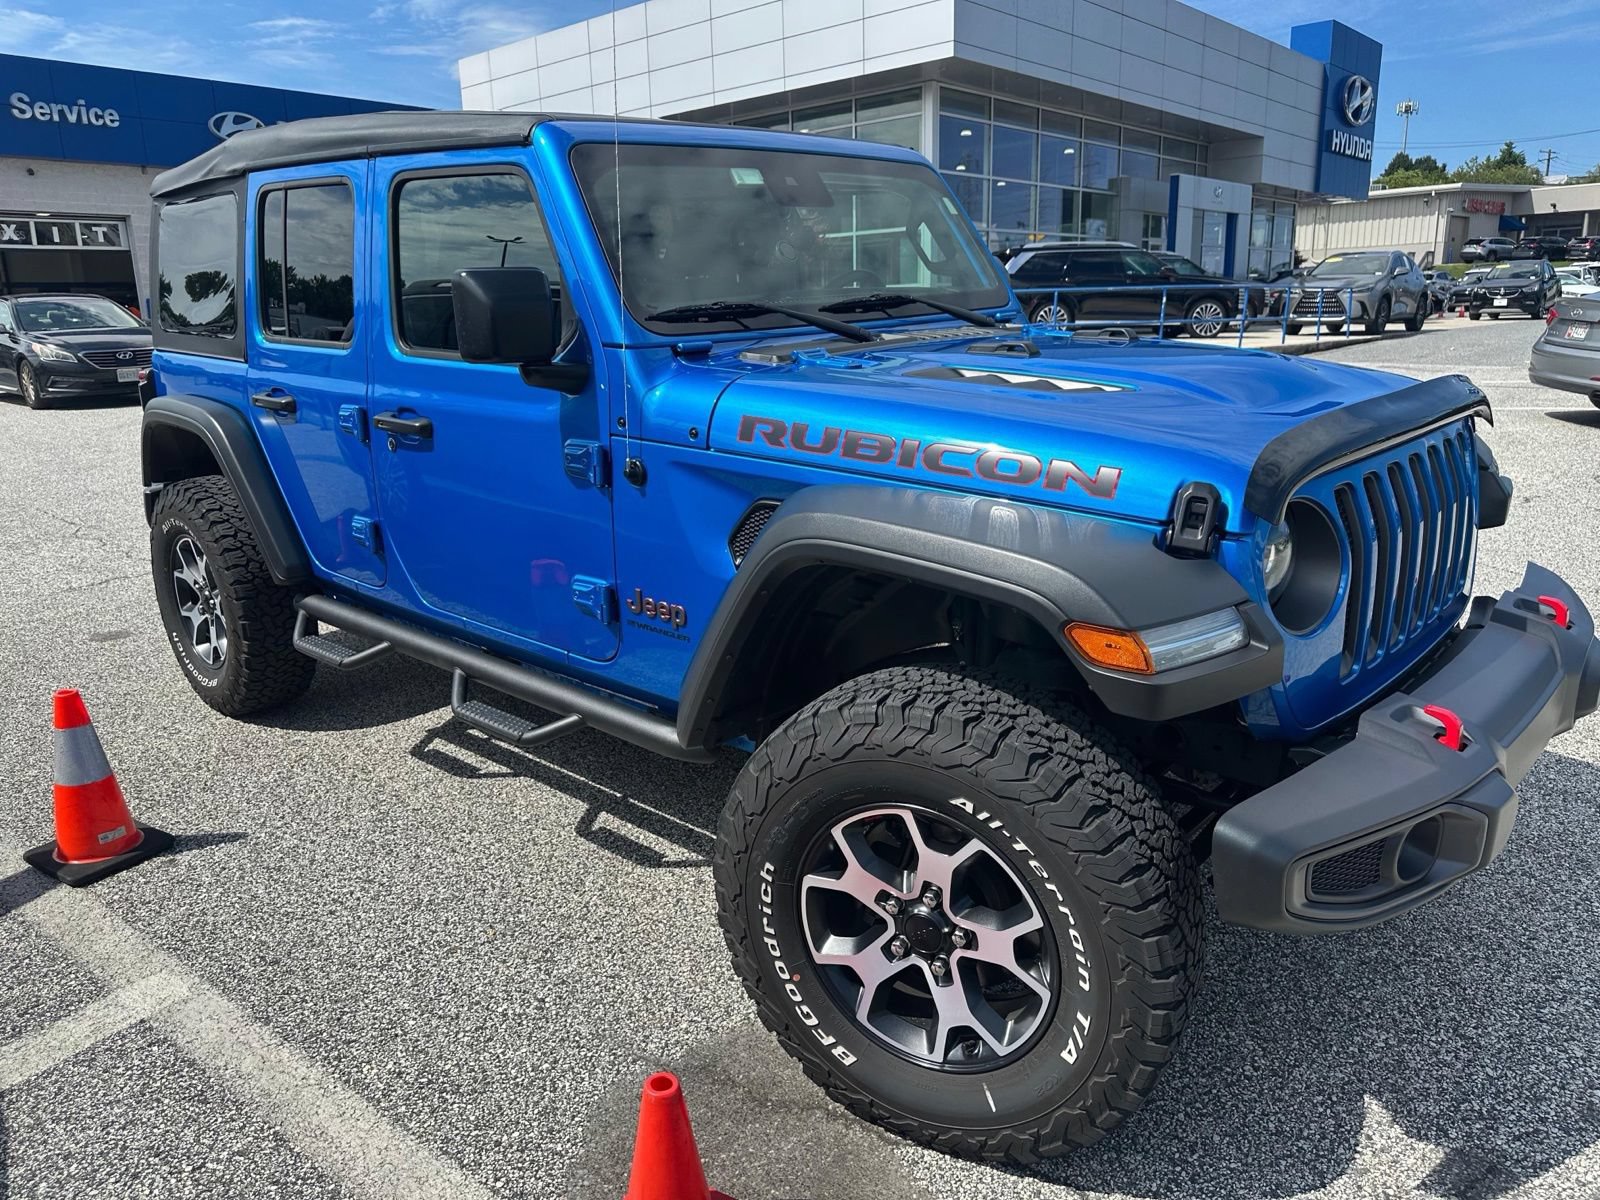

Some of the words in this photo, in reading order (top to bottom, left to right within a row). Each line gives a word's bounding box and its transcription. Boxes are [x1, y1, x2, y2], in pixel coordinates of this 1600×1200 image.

[9, 92, 120, 128] Service
[1331, 128, 1373, 161] HYUNDA
[737, 414, 1123, 500] RUBICON
[626, 588, 687, 631] Jeep
[947, 796, 1092, 992] All-Terrain
[1060, 1008, 1093, 1066] T/A
[758, 861, 858, 1068] BFGoodrich
